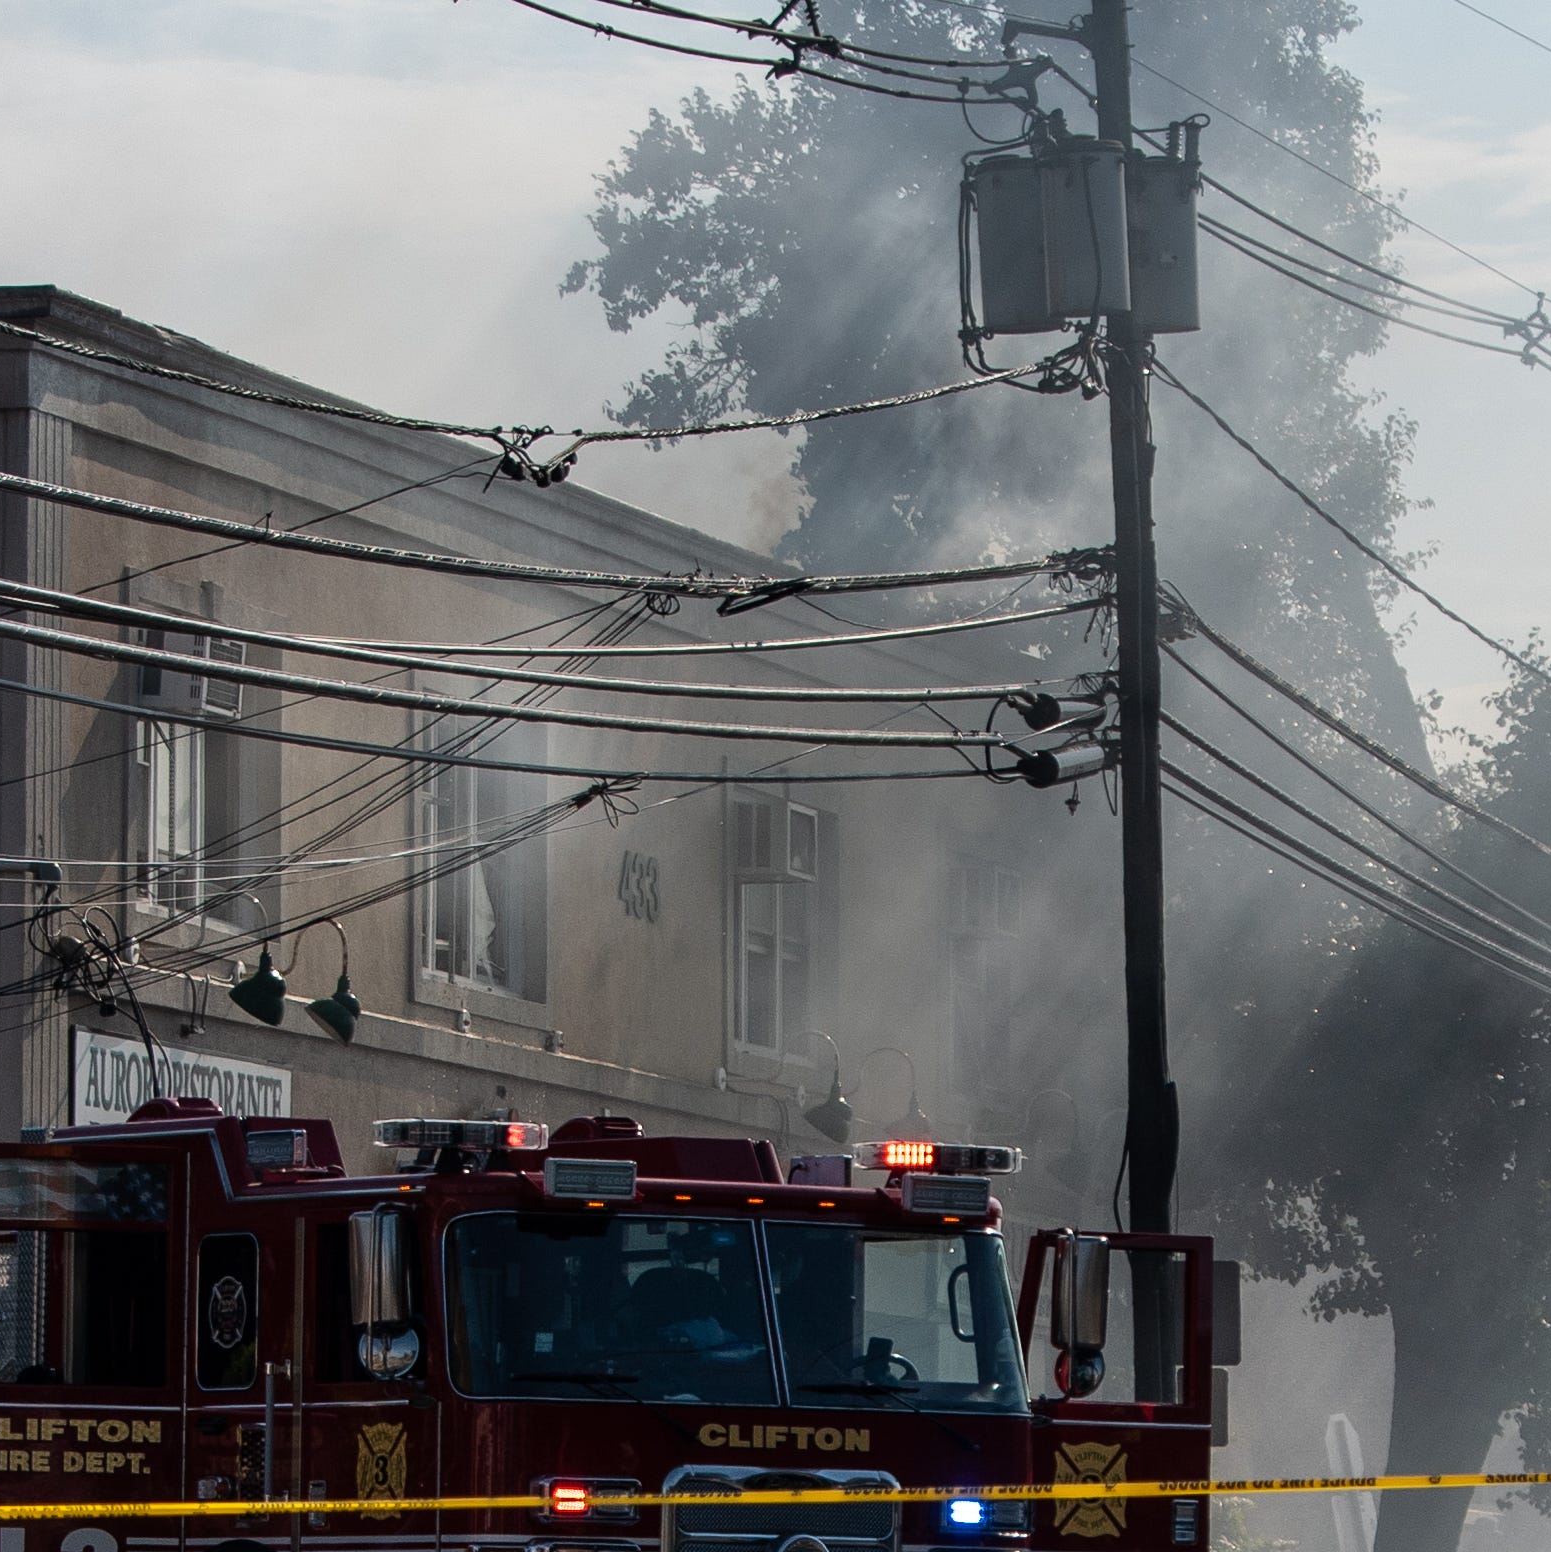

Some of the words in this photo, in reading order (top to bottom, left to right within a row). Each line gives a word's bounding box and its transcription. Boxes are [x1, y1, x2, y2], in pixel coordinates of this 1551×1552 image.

[619, 850, 658, 923] 433
[698, 1422, 871, 1453] CLIFTON
[63, 1450, 151, 1475] DEPT.
[374, 1455, 388, 1486] 3
